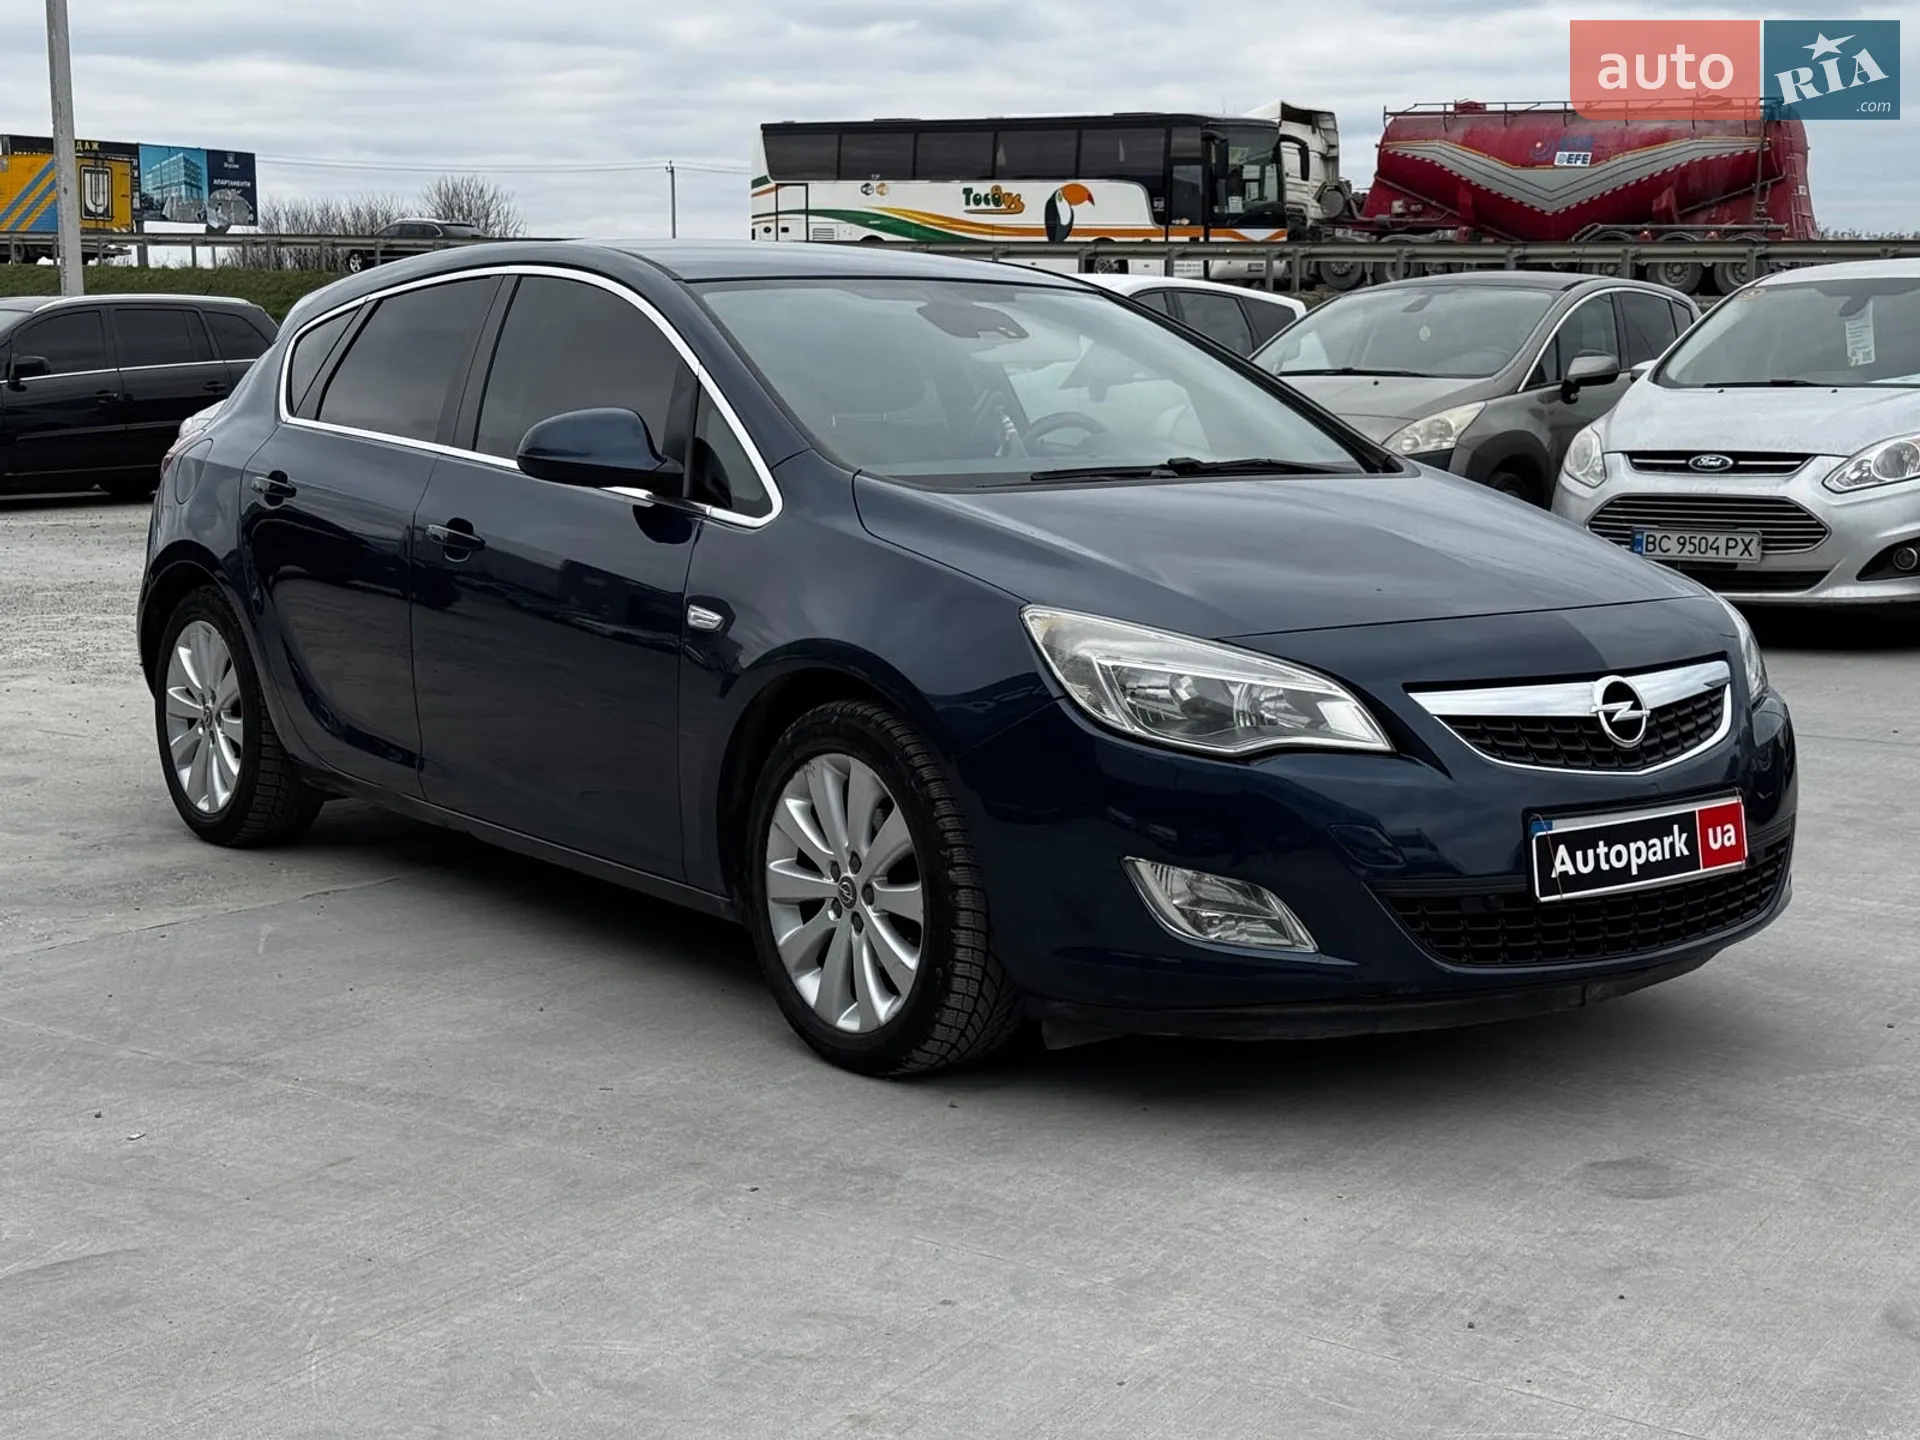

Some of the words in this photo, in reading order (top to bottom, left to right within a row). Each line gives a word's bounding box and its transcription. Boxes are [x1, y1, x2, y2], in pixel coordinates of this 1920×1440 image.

[75, 141, 100, 151] ДАЖ
[1566, 153, 1590, 165] EFE
[1697, 455, 1722, 468] Ford
[1644, 534, 1672, 553] BC
[1676, 535, 1720, 556] 9504
[1724, 537, 1755, 557] PX
[1551, 824, 1690, 878] Autopark
[1707, 823, 1737, 850] ua
